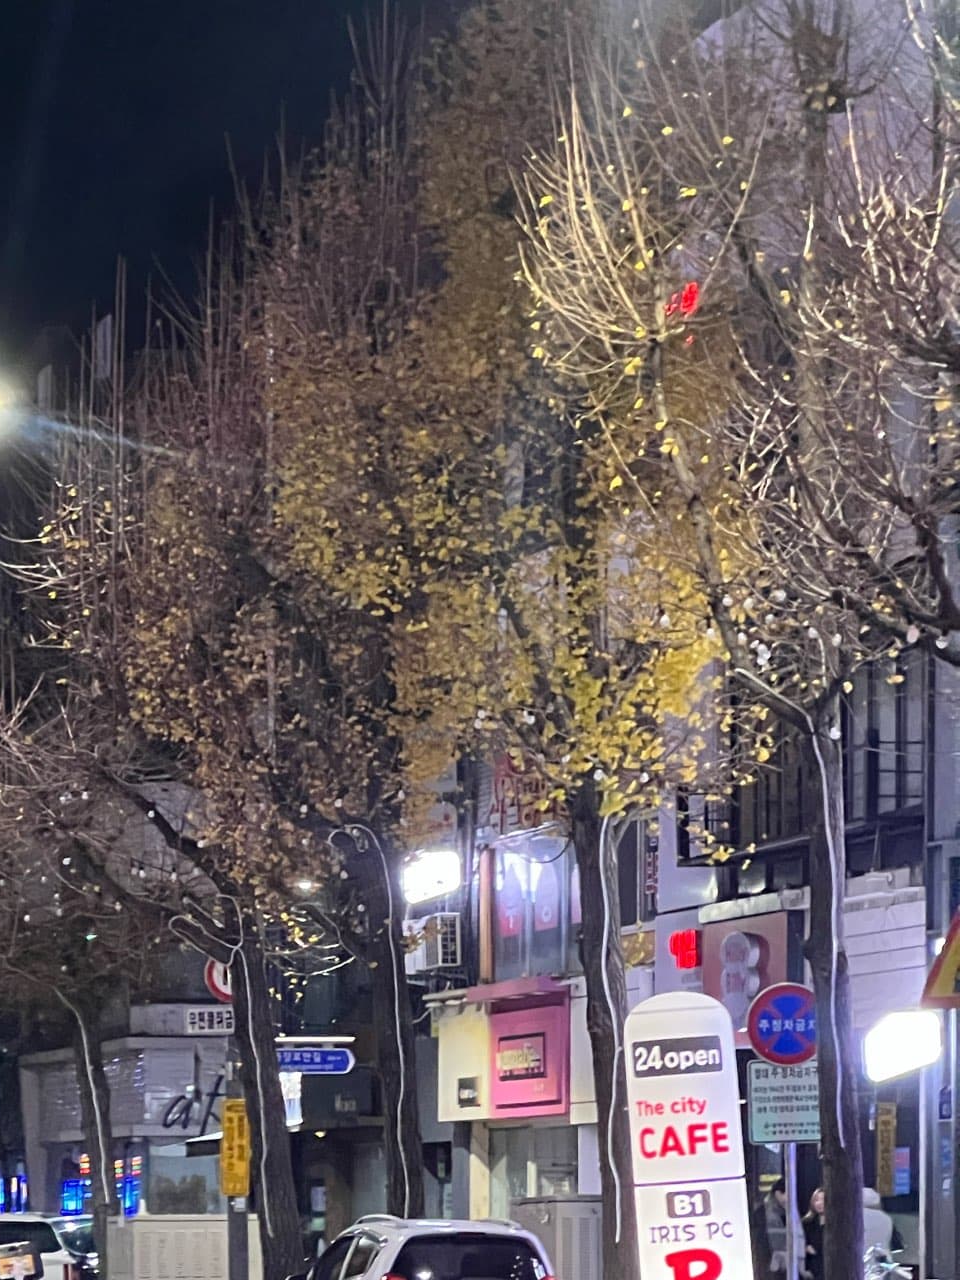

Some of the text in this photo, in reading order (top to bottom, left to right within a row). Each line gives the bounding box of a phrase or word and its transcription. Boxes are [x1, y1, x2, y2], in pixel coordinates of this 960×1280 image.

[636, 1097, 707, 1116] The city
[640, 1122, 730, 1159] CAFE
[673, 1193, 704, 1216] B1
[649, 1221, 734, 1244] IRIS PC
